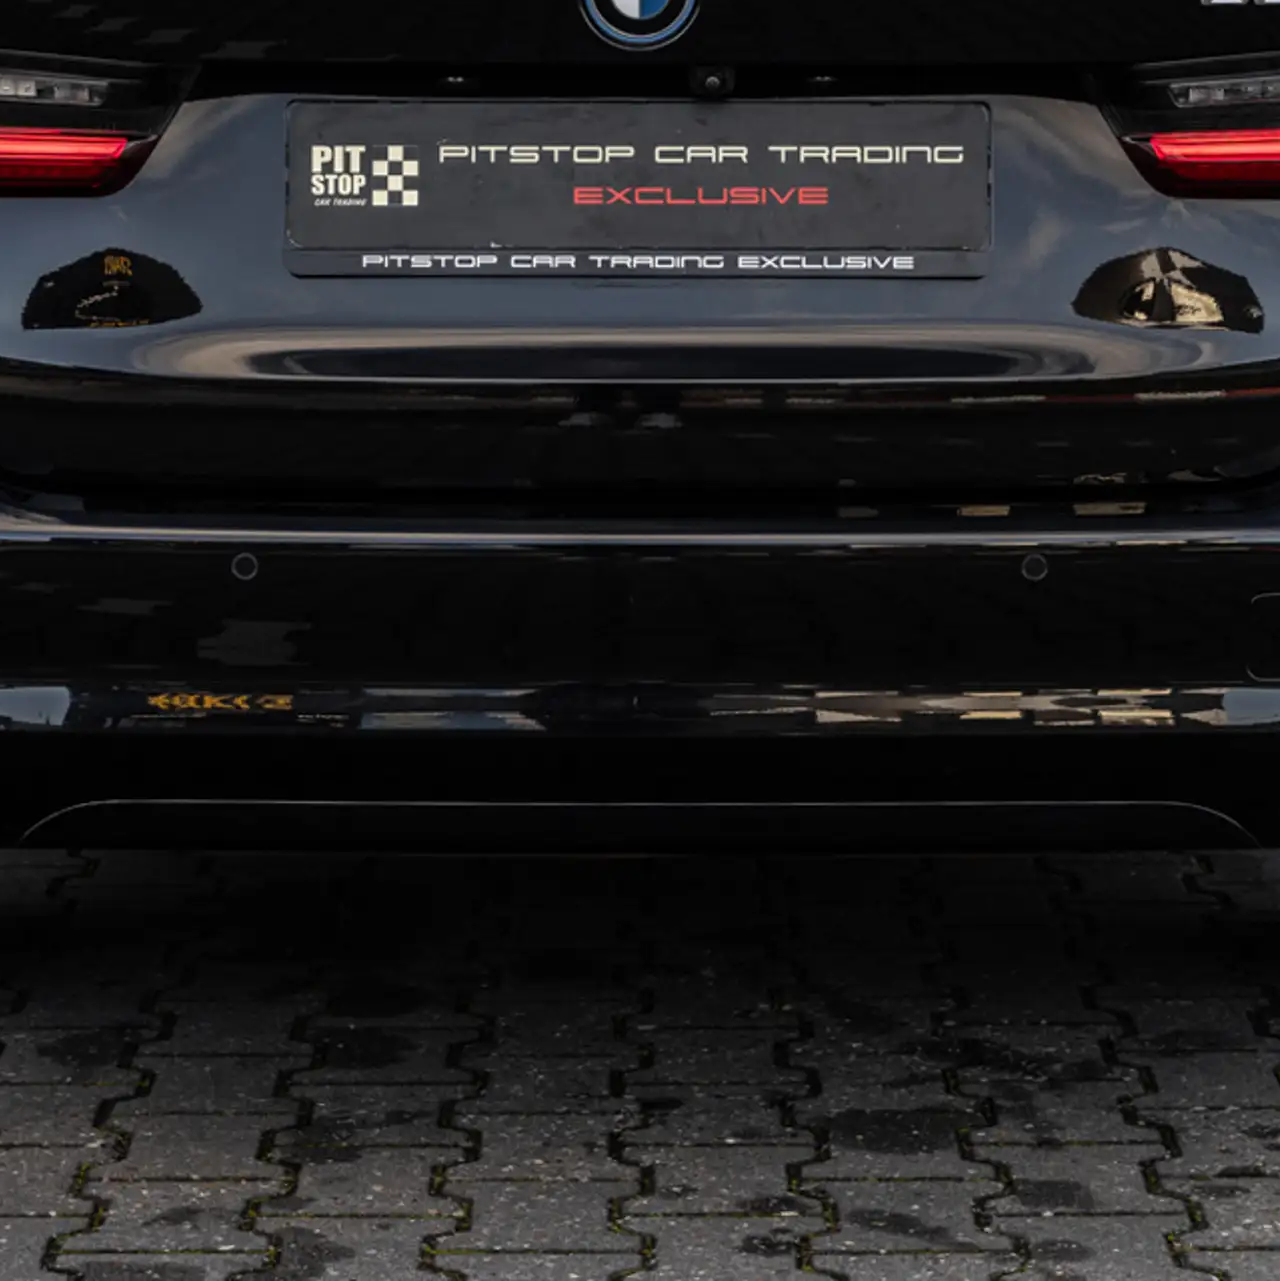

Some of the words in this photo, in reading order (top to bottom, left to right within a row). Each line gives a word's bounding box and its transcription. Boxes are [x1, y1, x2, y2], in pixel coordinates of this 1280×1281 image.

[311, 145, 367, 173] PIT
[439, 145, 635, 164] PITSTOP
[655, 145, 748, 164] CAR
[768, 145, 964, 164] TRADING
[311, 174, 367, 196] STOP
[573, 187, 828, 205] EXCLUSIVE
[362, 255, 501, 269] PITSTOP
[510, 255, 576, 269] CAR
[588, 255, 724, 269] TRADING
[738, 255, 914, 269] EXCLUSIVE
